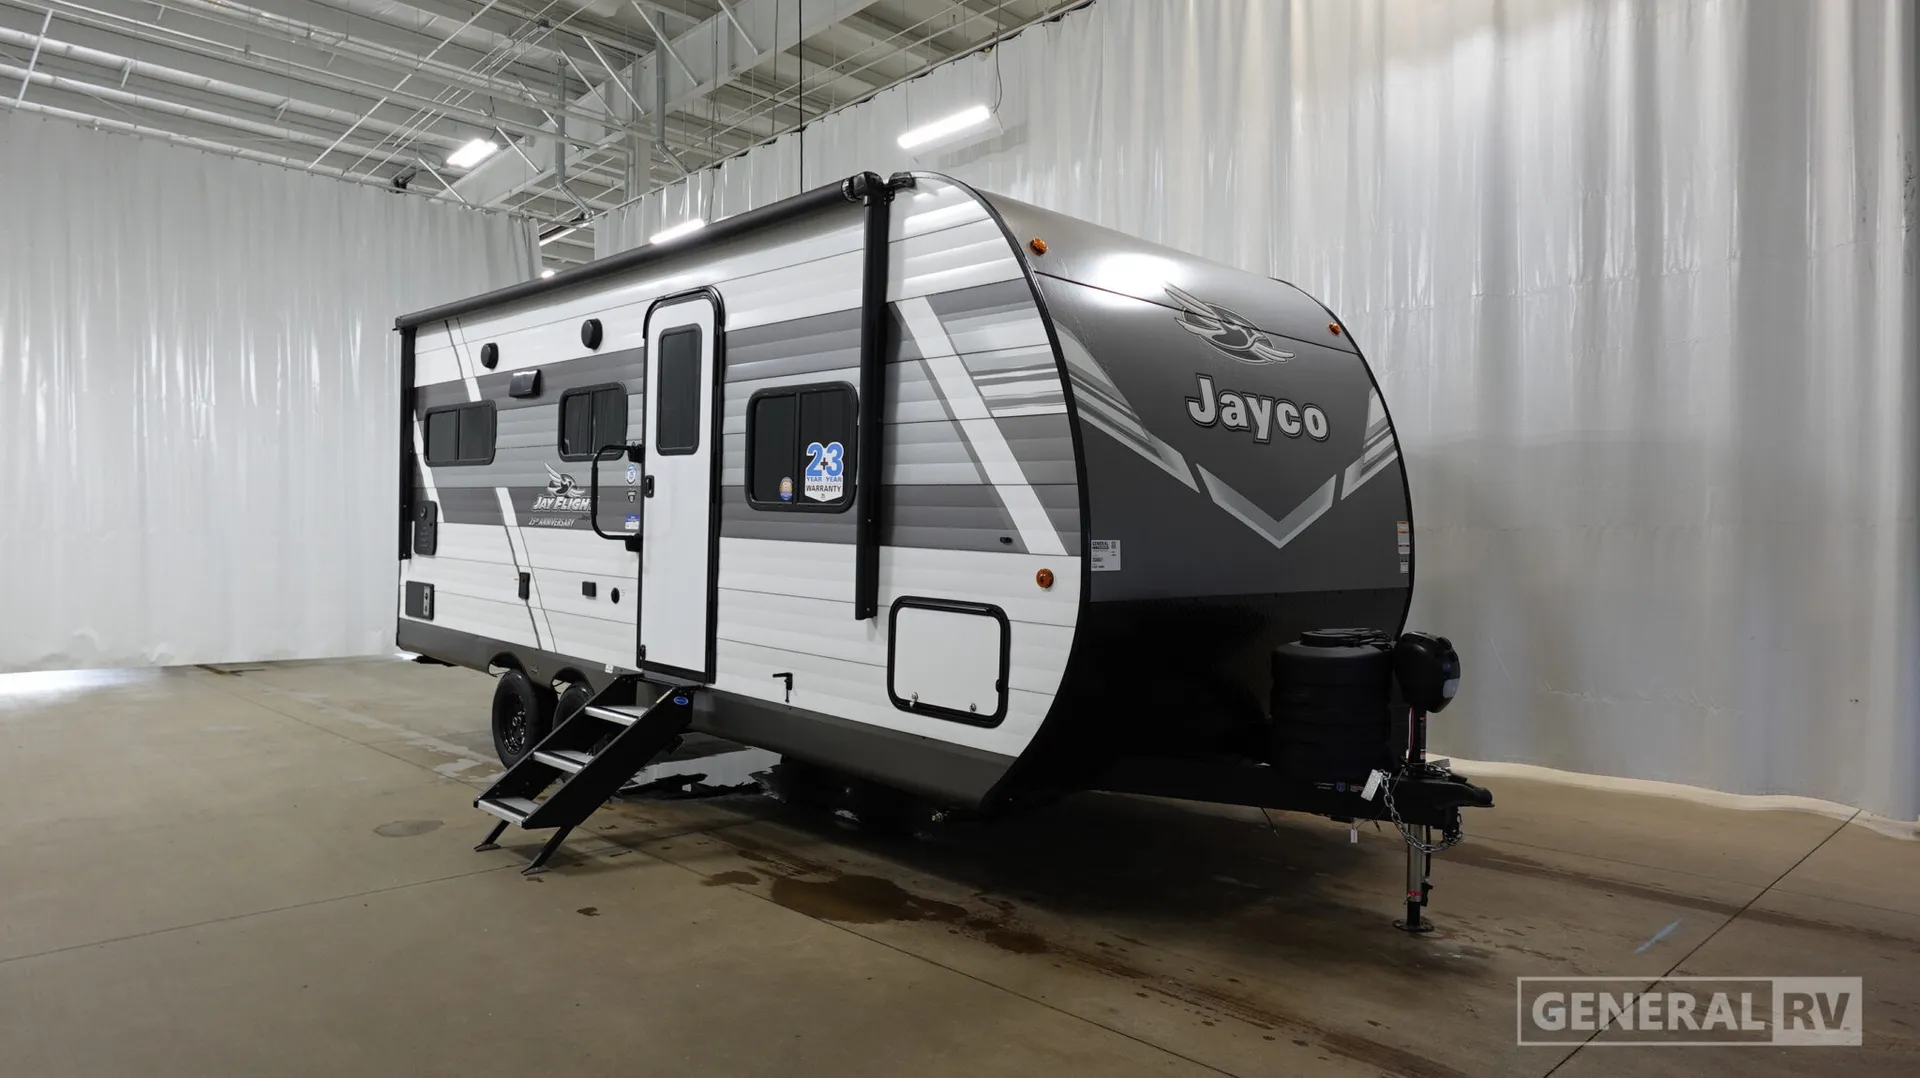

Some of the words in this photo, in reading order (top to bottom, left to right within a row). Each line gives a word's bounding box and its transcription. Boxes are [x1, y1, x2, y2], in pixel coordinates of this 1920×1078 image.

[1186, 374, 1330, 443] Jayco
[806, 484, 842, 493] WARRANTY
[532, 496, 554, 511] JAY
[553, 496, 598, 512] FLIGH
[538, 518, 575, 528] ANNIVERSARY
